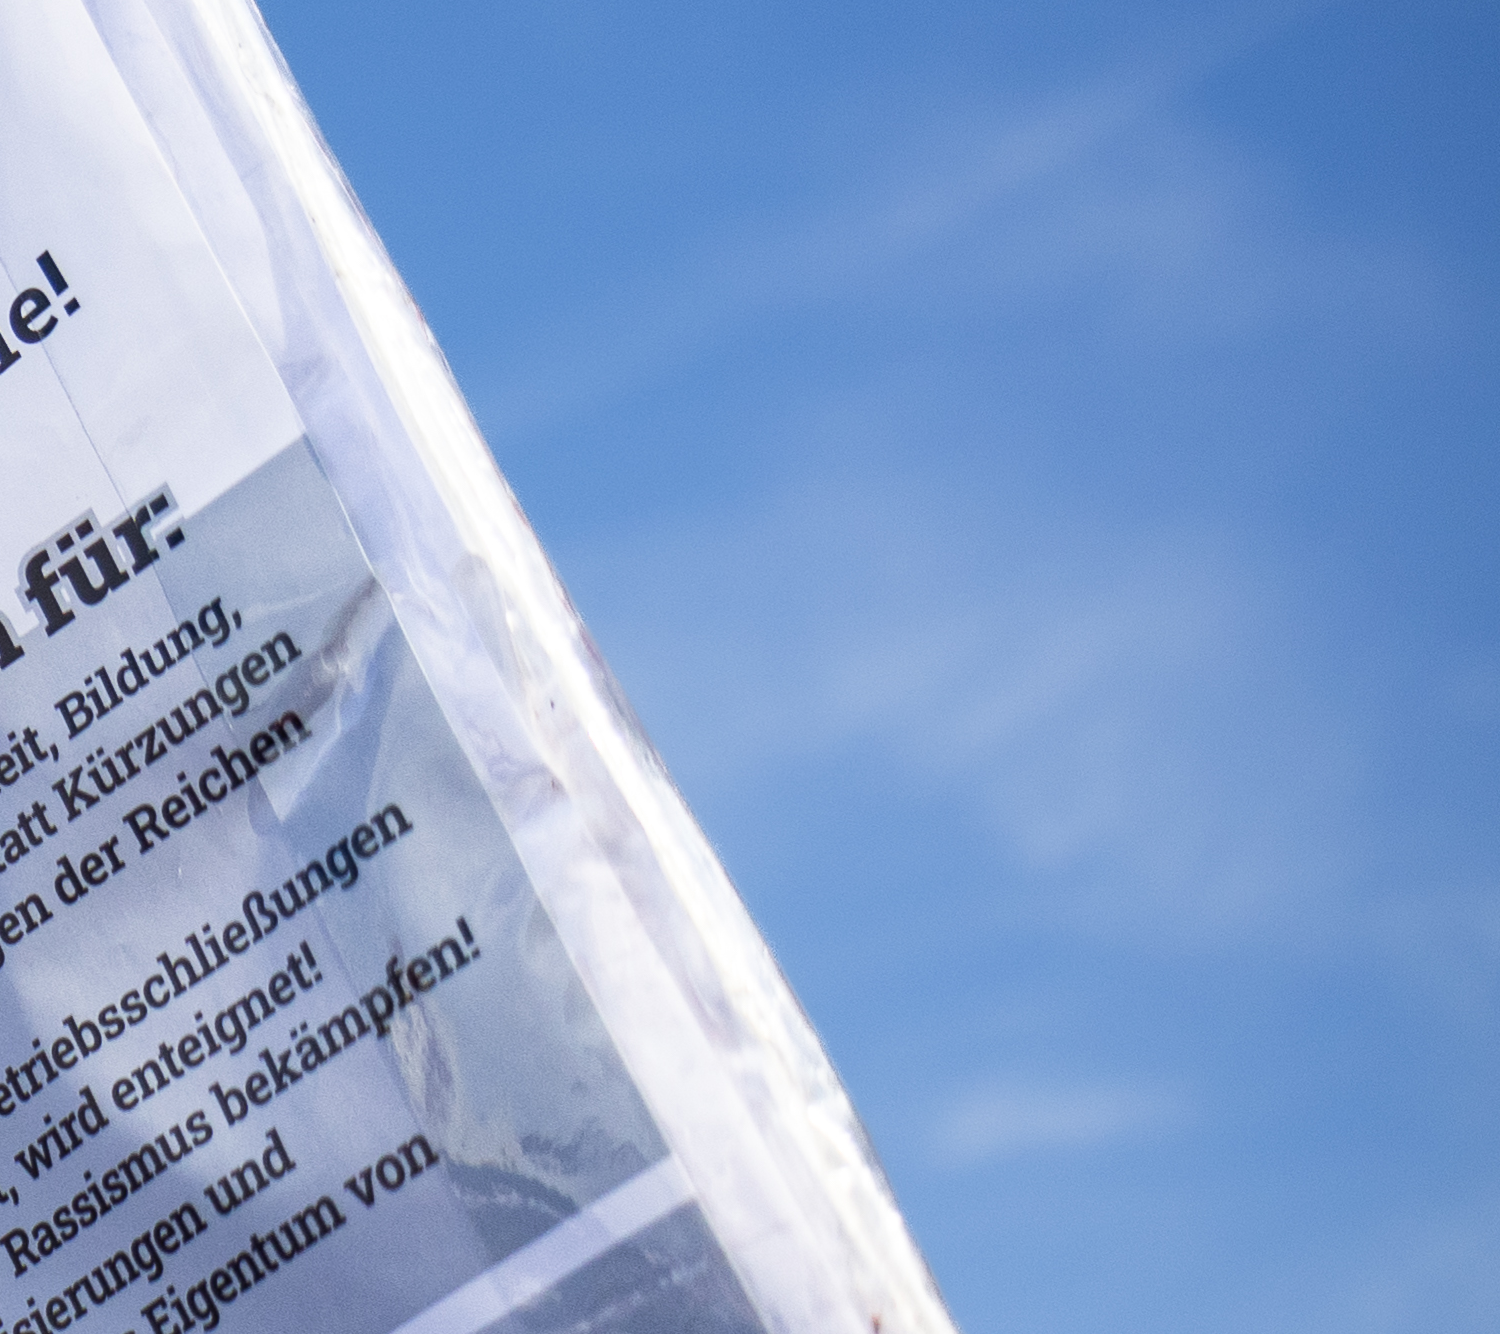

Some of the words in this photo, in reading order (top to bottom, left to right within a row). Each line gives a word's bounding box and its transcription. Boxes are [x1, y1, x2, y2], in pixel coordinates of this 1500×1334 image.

[24, 492, 184, 636] für:
[51, 621, 301, 822] Kürzungen
[54, 597, 241, 763] Bildung,
[54, 835, 125, 905] der
[122, 711, 310, 854] Reichen
[0, 1110, 213, 1277] Rassismus
[208, 916, 480, 1126] bekämpfen!
[14, 1086, 109, 1179] wird
[111, 941, 322, 1111] enteignet!
[204, 1127, 295, 1215] und
[344, 1135, 439, 1207] von
